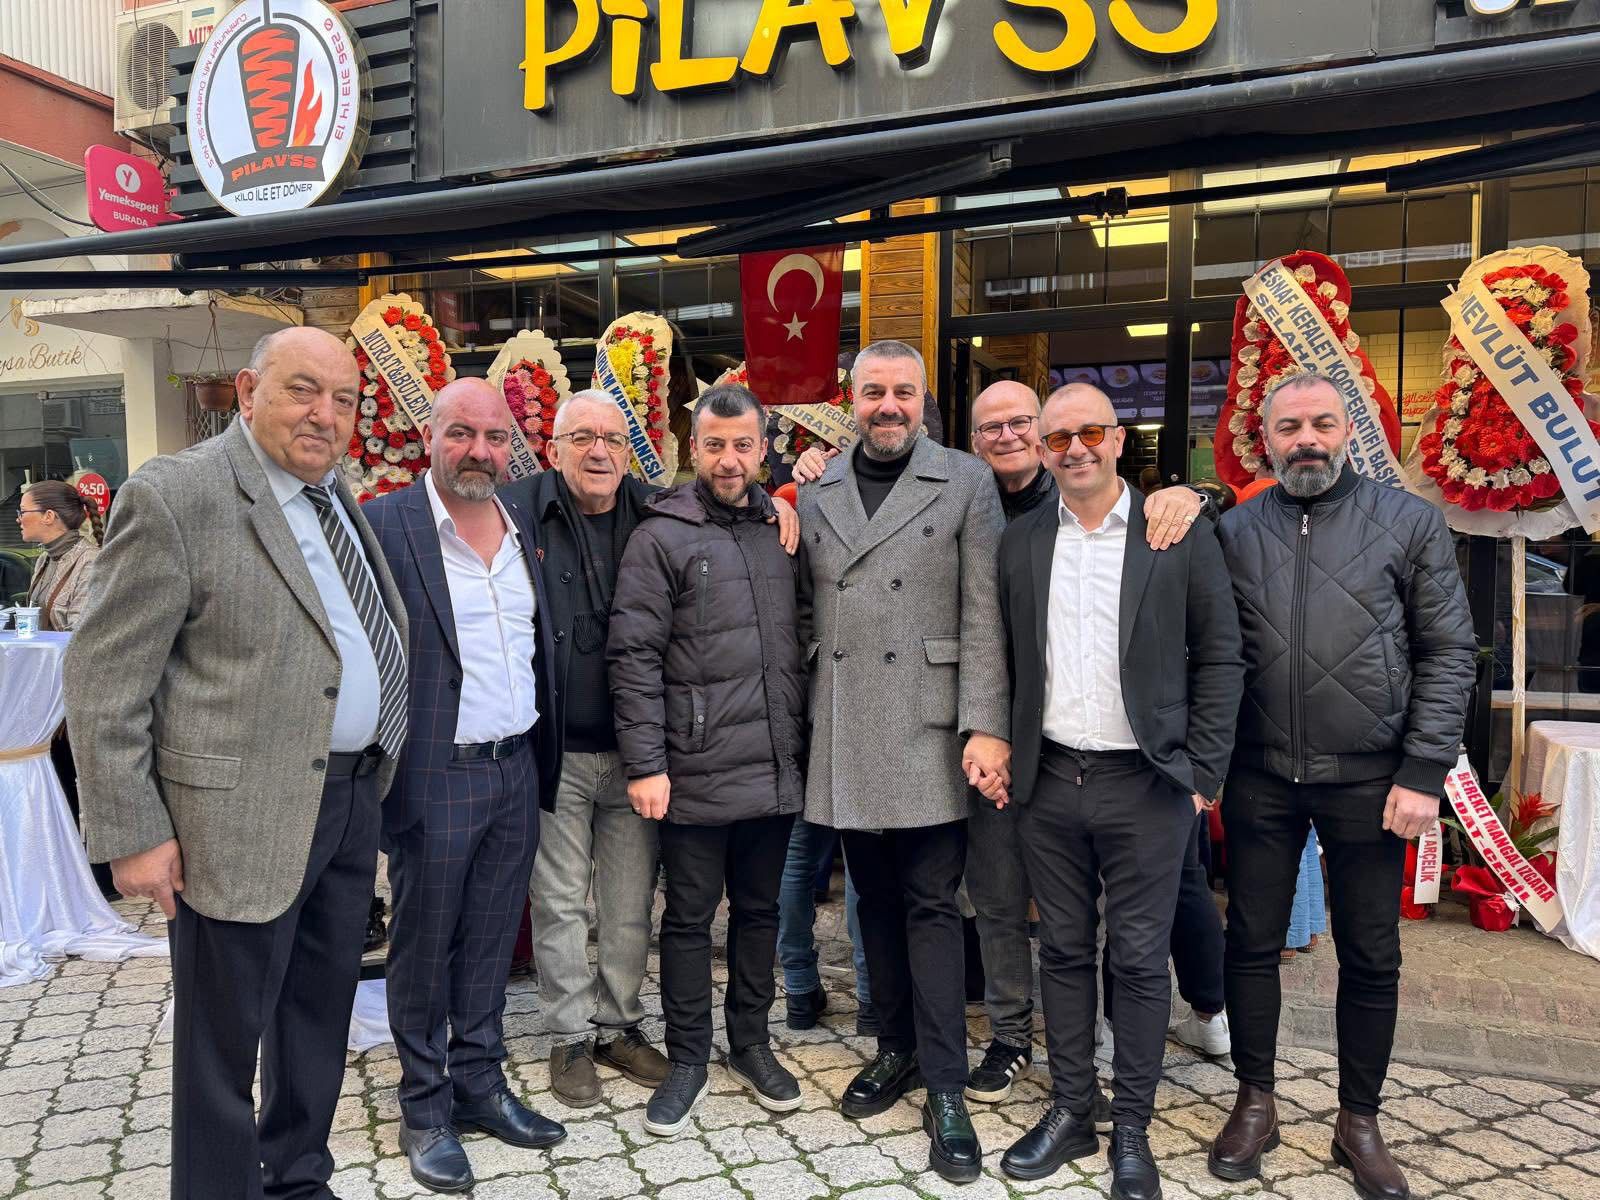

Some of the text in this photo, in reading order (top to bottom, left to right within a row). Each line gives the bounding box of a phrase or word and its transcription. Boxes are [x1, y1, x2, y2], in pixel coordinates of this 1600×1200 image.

[98, 187, 159, 214] Yemeksepeti
[255, 187, 269, 201] İLE
[270, 186, 282, 201] ET
[282, 183, 313, 198] DÖNER
[113, 211, 148, 227] BURADA
[29, 342, 82, 370] Butik
[1260, 267, 1298, 304] ESNAF
[1286, 302, 1338, 367] KEFALET
[1369, 447, 1405, 491] BAŞK
[1349, 438, 1374, 479] BA
[79, 482, 105, 496] %50
[1456, 771, 1494, 819] BEREKET
[1483, 818, 1525, 869] MANGAL
[1418, 839, 1438, 884] ARÇELİK
